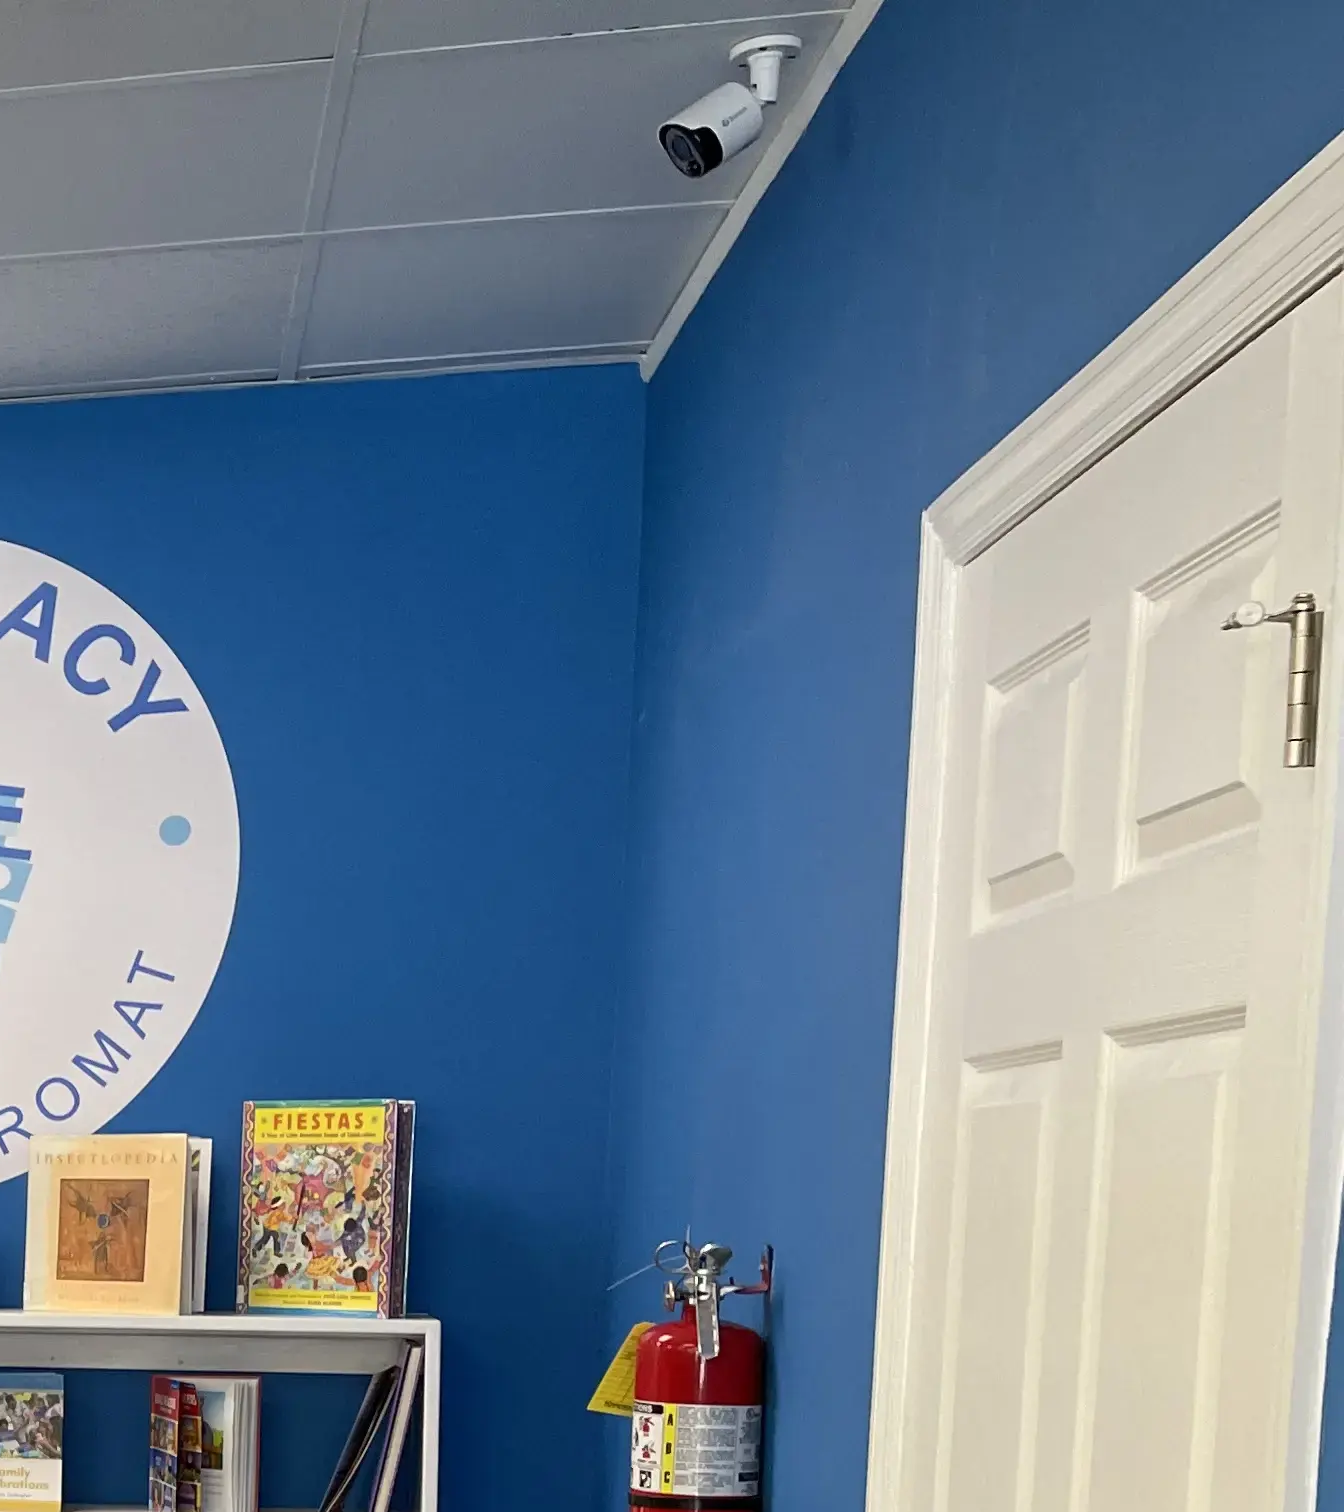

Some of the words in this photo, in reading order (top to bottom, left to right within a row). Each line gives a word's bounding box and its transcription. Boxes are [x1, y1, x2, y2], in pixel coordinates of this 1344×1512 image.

[273, 1112, 364, 1130] FIESTAS
[667, 1413, 674, 1426] A
[664, 1471, 671, 1483] C
